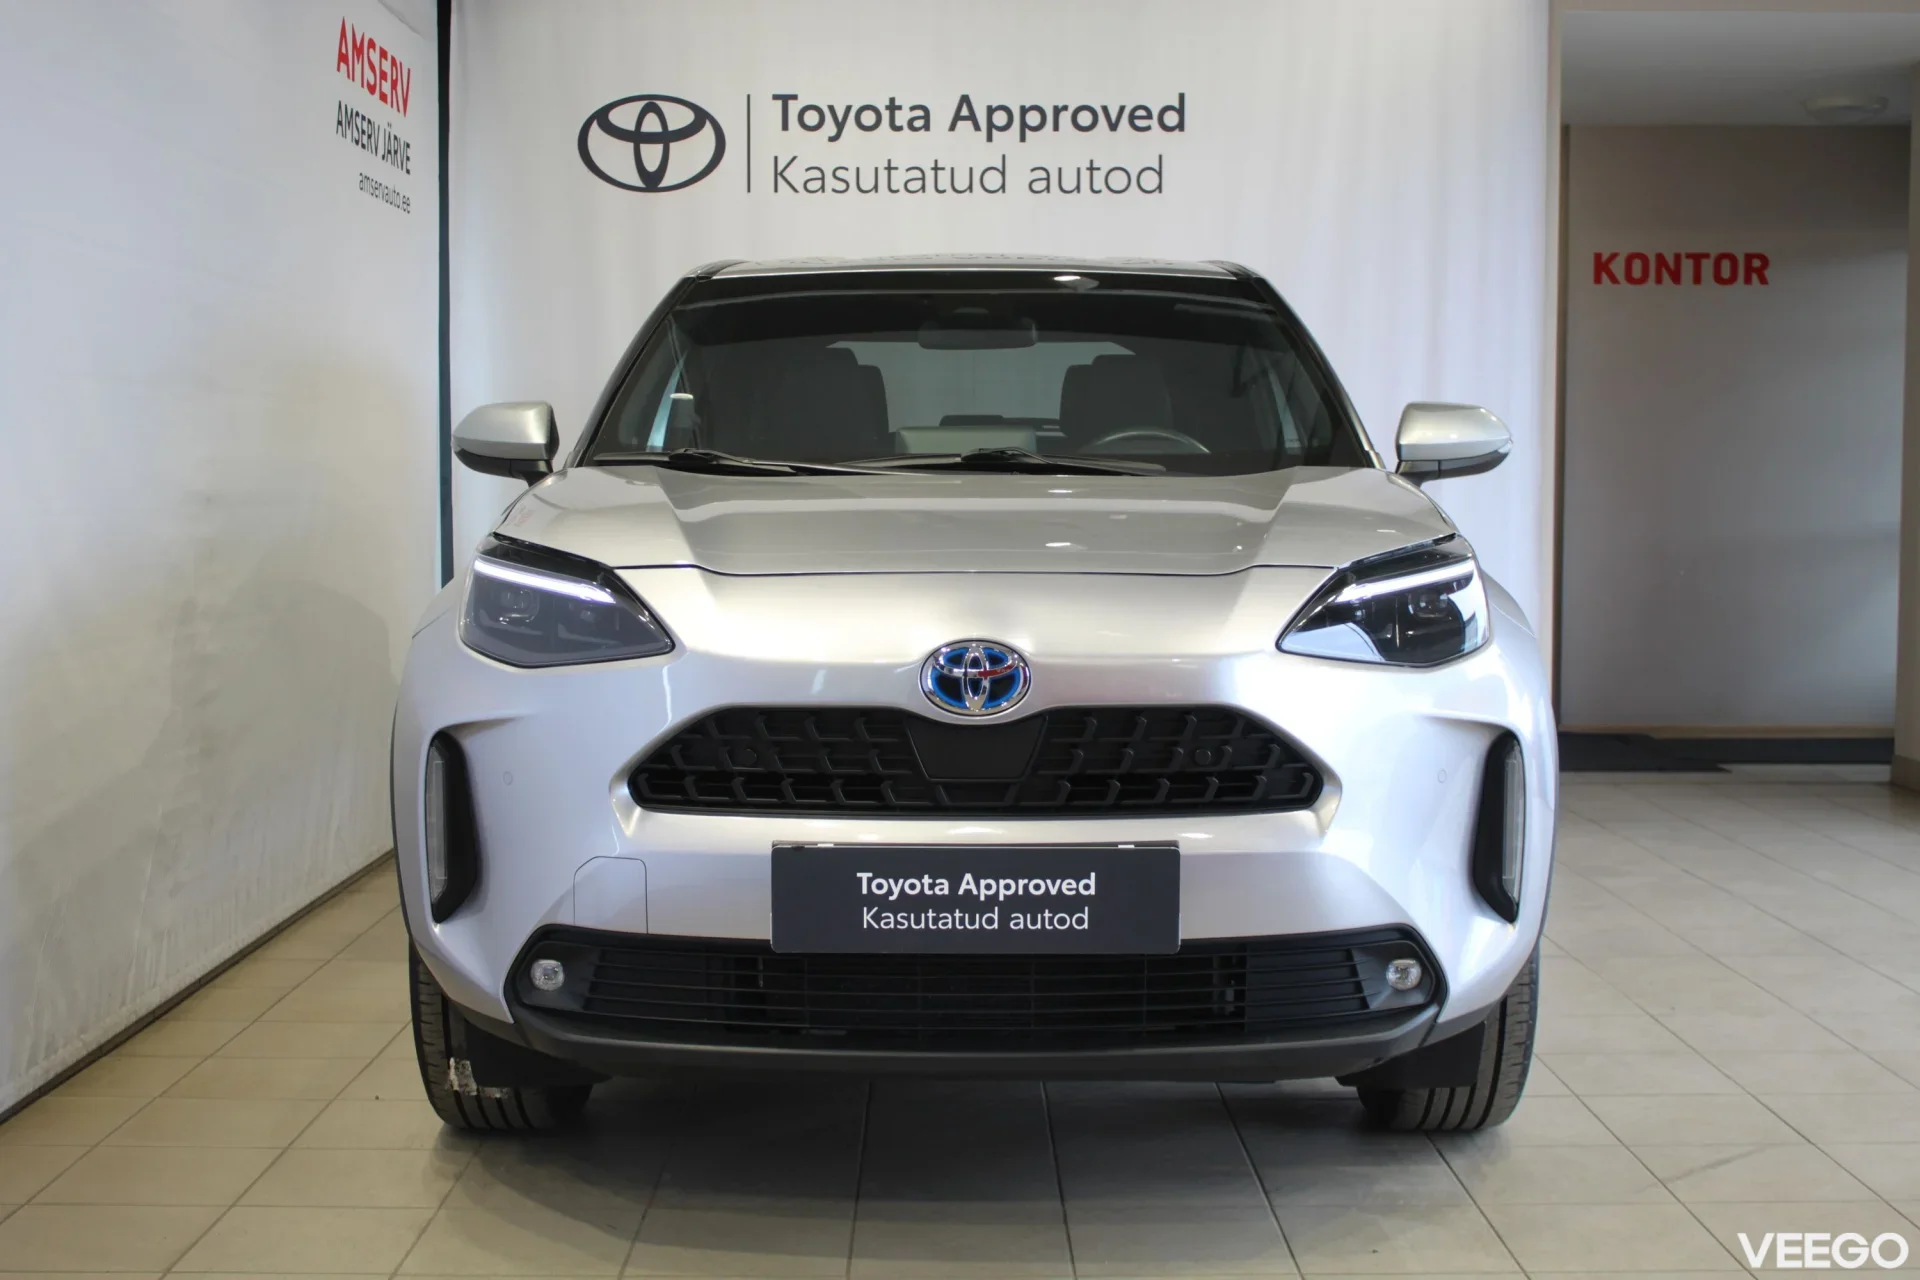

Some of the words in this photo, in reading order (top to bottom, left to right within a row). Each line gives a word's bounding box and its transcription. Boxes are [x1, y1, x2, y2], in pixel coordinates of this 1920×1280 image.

[336, 16, 411, 118] AMSERV
[336, 100, 380, 157] AMSERV
[382, 122, 411, 175] JÄRVE
[772, 93, 932, 142] Toyota
[948, 92, 1186, 142] Approved
[359, 172, 411, 214] amservauto.ee
[773, 154, 1007, 194] Kasutatud
[1027, 154, 1164, 194] autod
[1593, 252, 1770, 285] KONTOR
[856, 872, 949, 901] Toyota
[958, 872, 1096, 901] Approved
[863, 906, 999, 930] Kasutatud
[1009, 906, 1089, 930] autod
